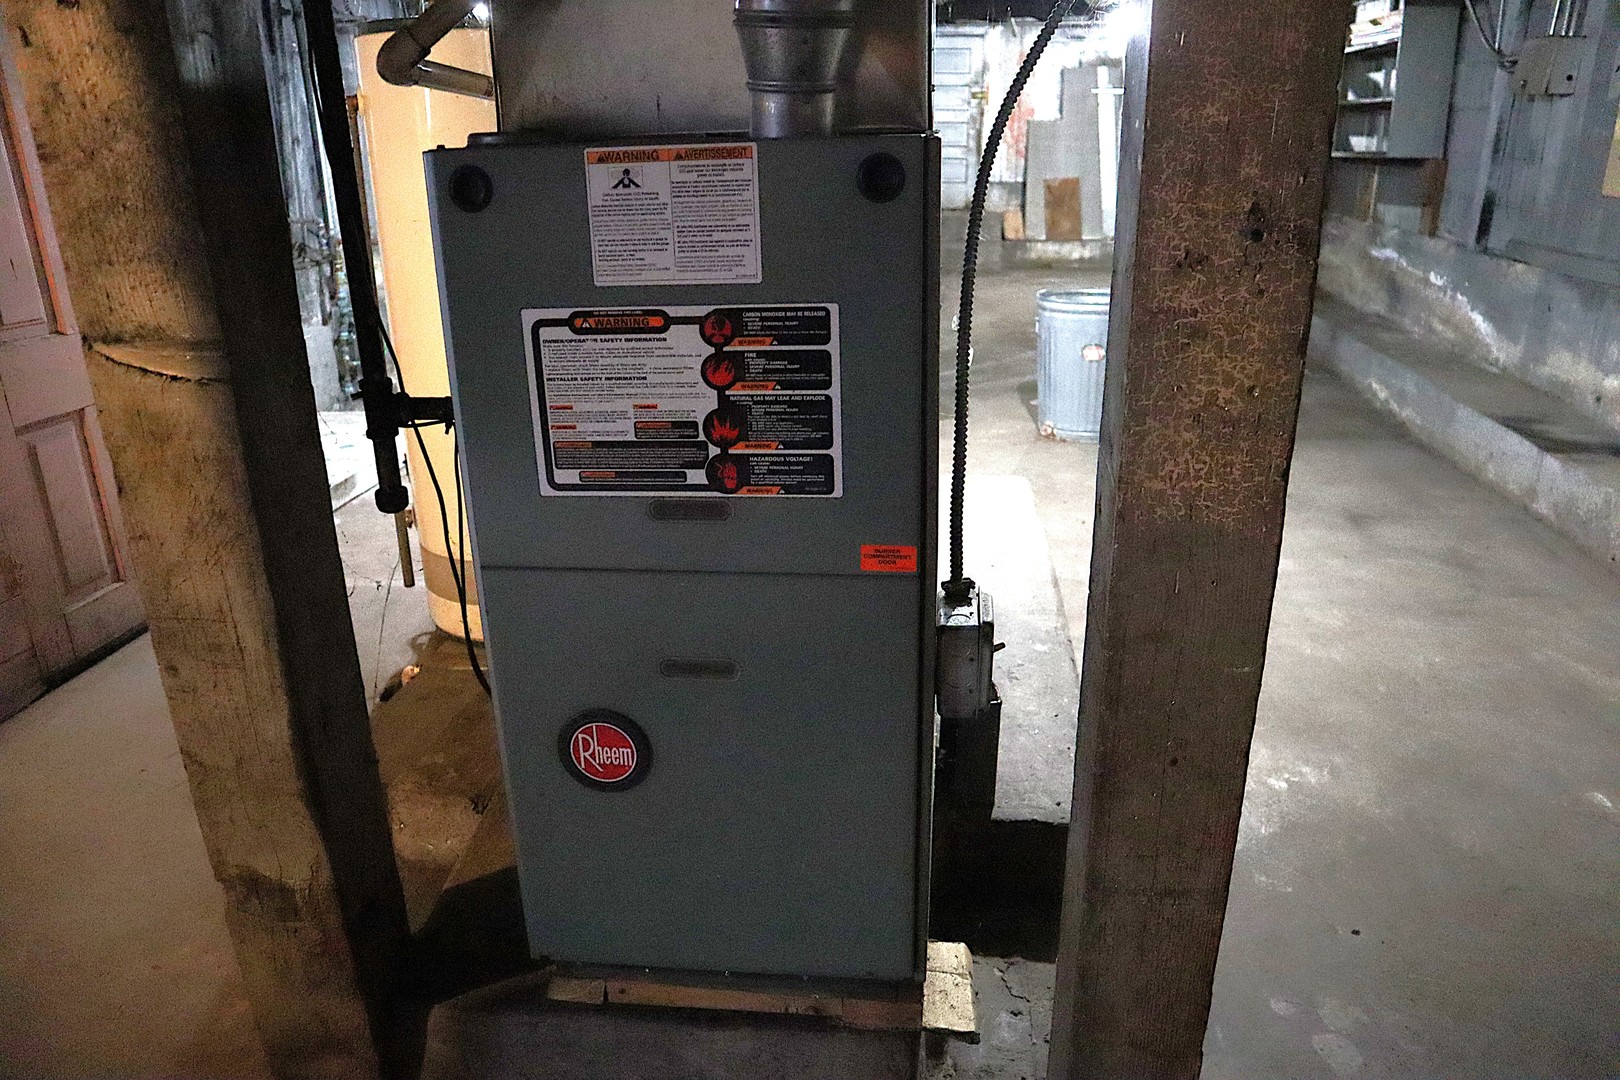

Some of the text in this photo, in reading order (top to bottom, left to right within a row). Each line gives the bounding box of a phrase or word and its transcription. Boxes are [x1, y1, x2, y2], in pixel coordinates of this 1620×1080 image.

[604, 150, 660, 163] WARNING
[684, 147, 747, 160] AVERTISSEMENT
[594, 316, 650, 329] WARNING
[577, 725, 632, 771] Rheem
